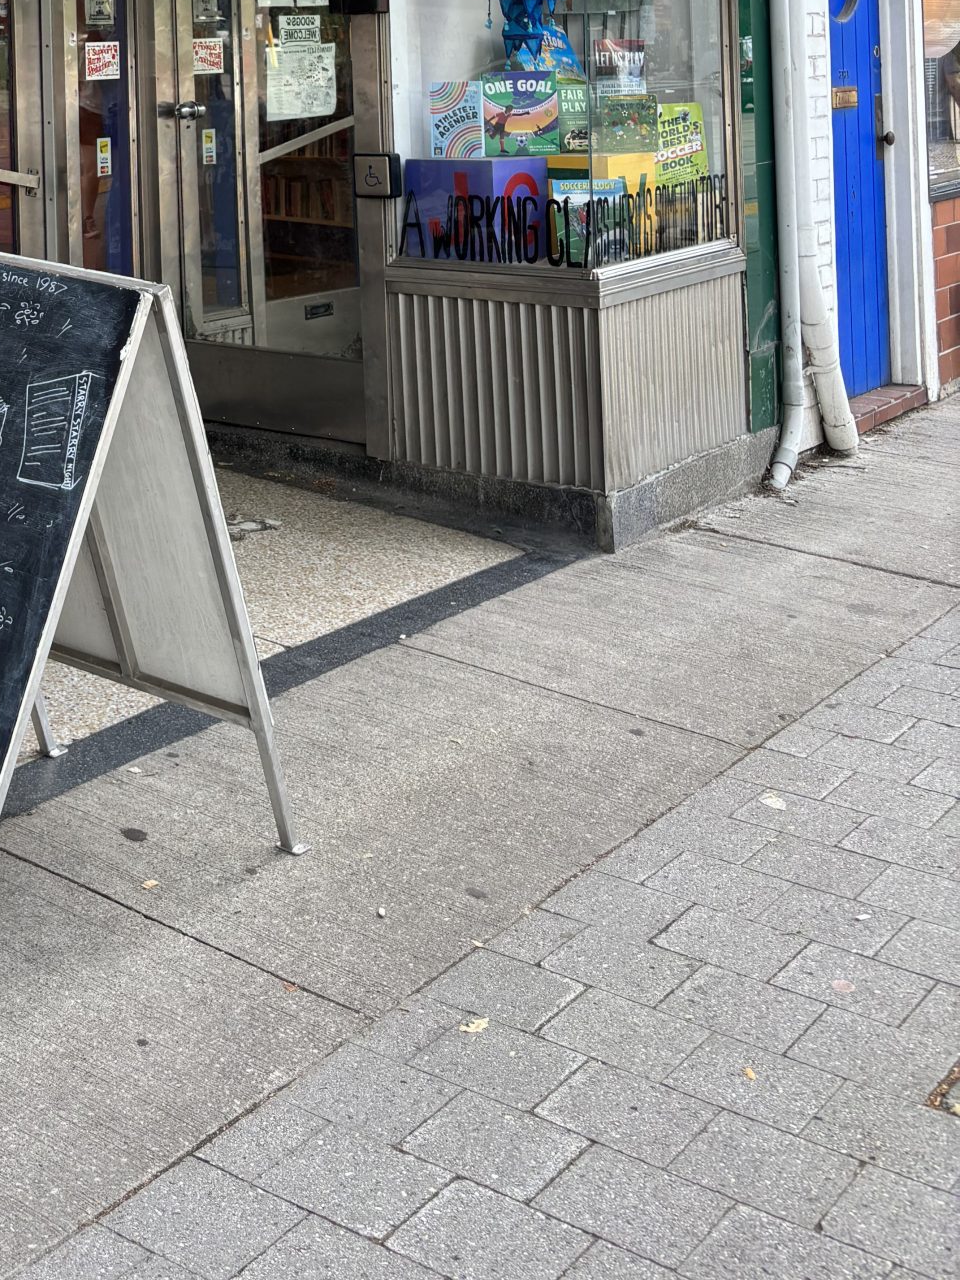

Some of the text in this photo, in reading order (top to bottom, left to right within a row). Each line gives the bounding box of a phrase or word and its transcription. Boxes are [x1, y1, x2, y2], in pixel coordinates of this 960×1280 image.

[596, 51, 645, 67] LET US PLAY
[485, 79, 553, 95] ONE GOAL
[561, 89, 584, 100] FAIR
[562, 102, 587, 113] PLAY
[434, 106, 468, 131] ATHLETE
[438, 111, 478, 139] AGENDER
[660, 116, 681, 130] THE
[661, 121, 700, 139] ORLD'S
[662, 134, 689, 149] BEST
[662, 154, 694, 172] BOOK
[560, 181, 617, 191] SOCCERLOGY
[399, 189, 426, 258] A
[432, 194, 539, 264] WORKING
[545, 195, 609, 270] CLASS
[2, 271, 29, 287] since
[35, 276, 68, 295] 1987
[63, 376, 88, 488] STARRY STARRY NIGHT
